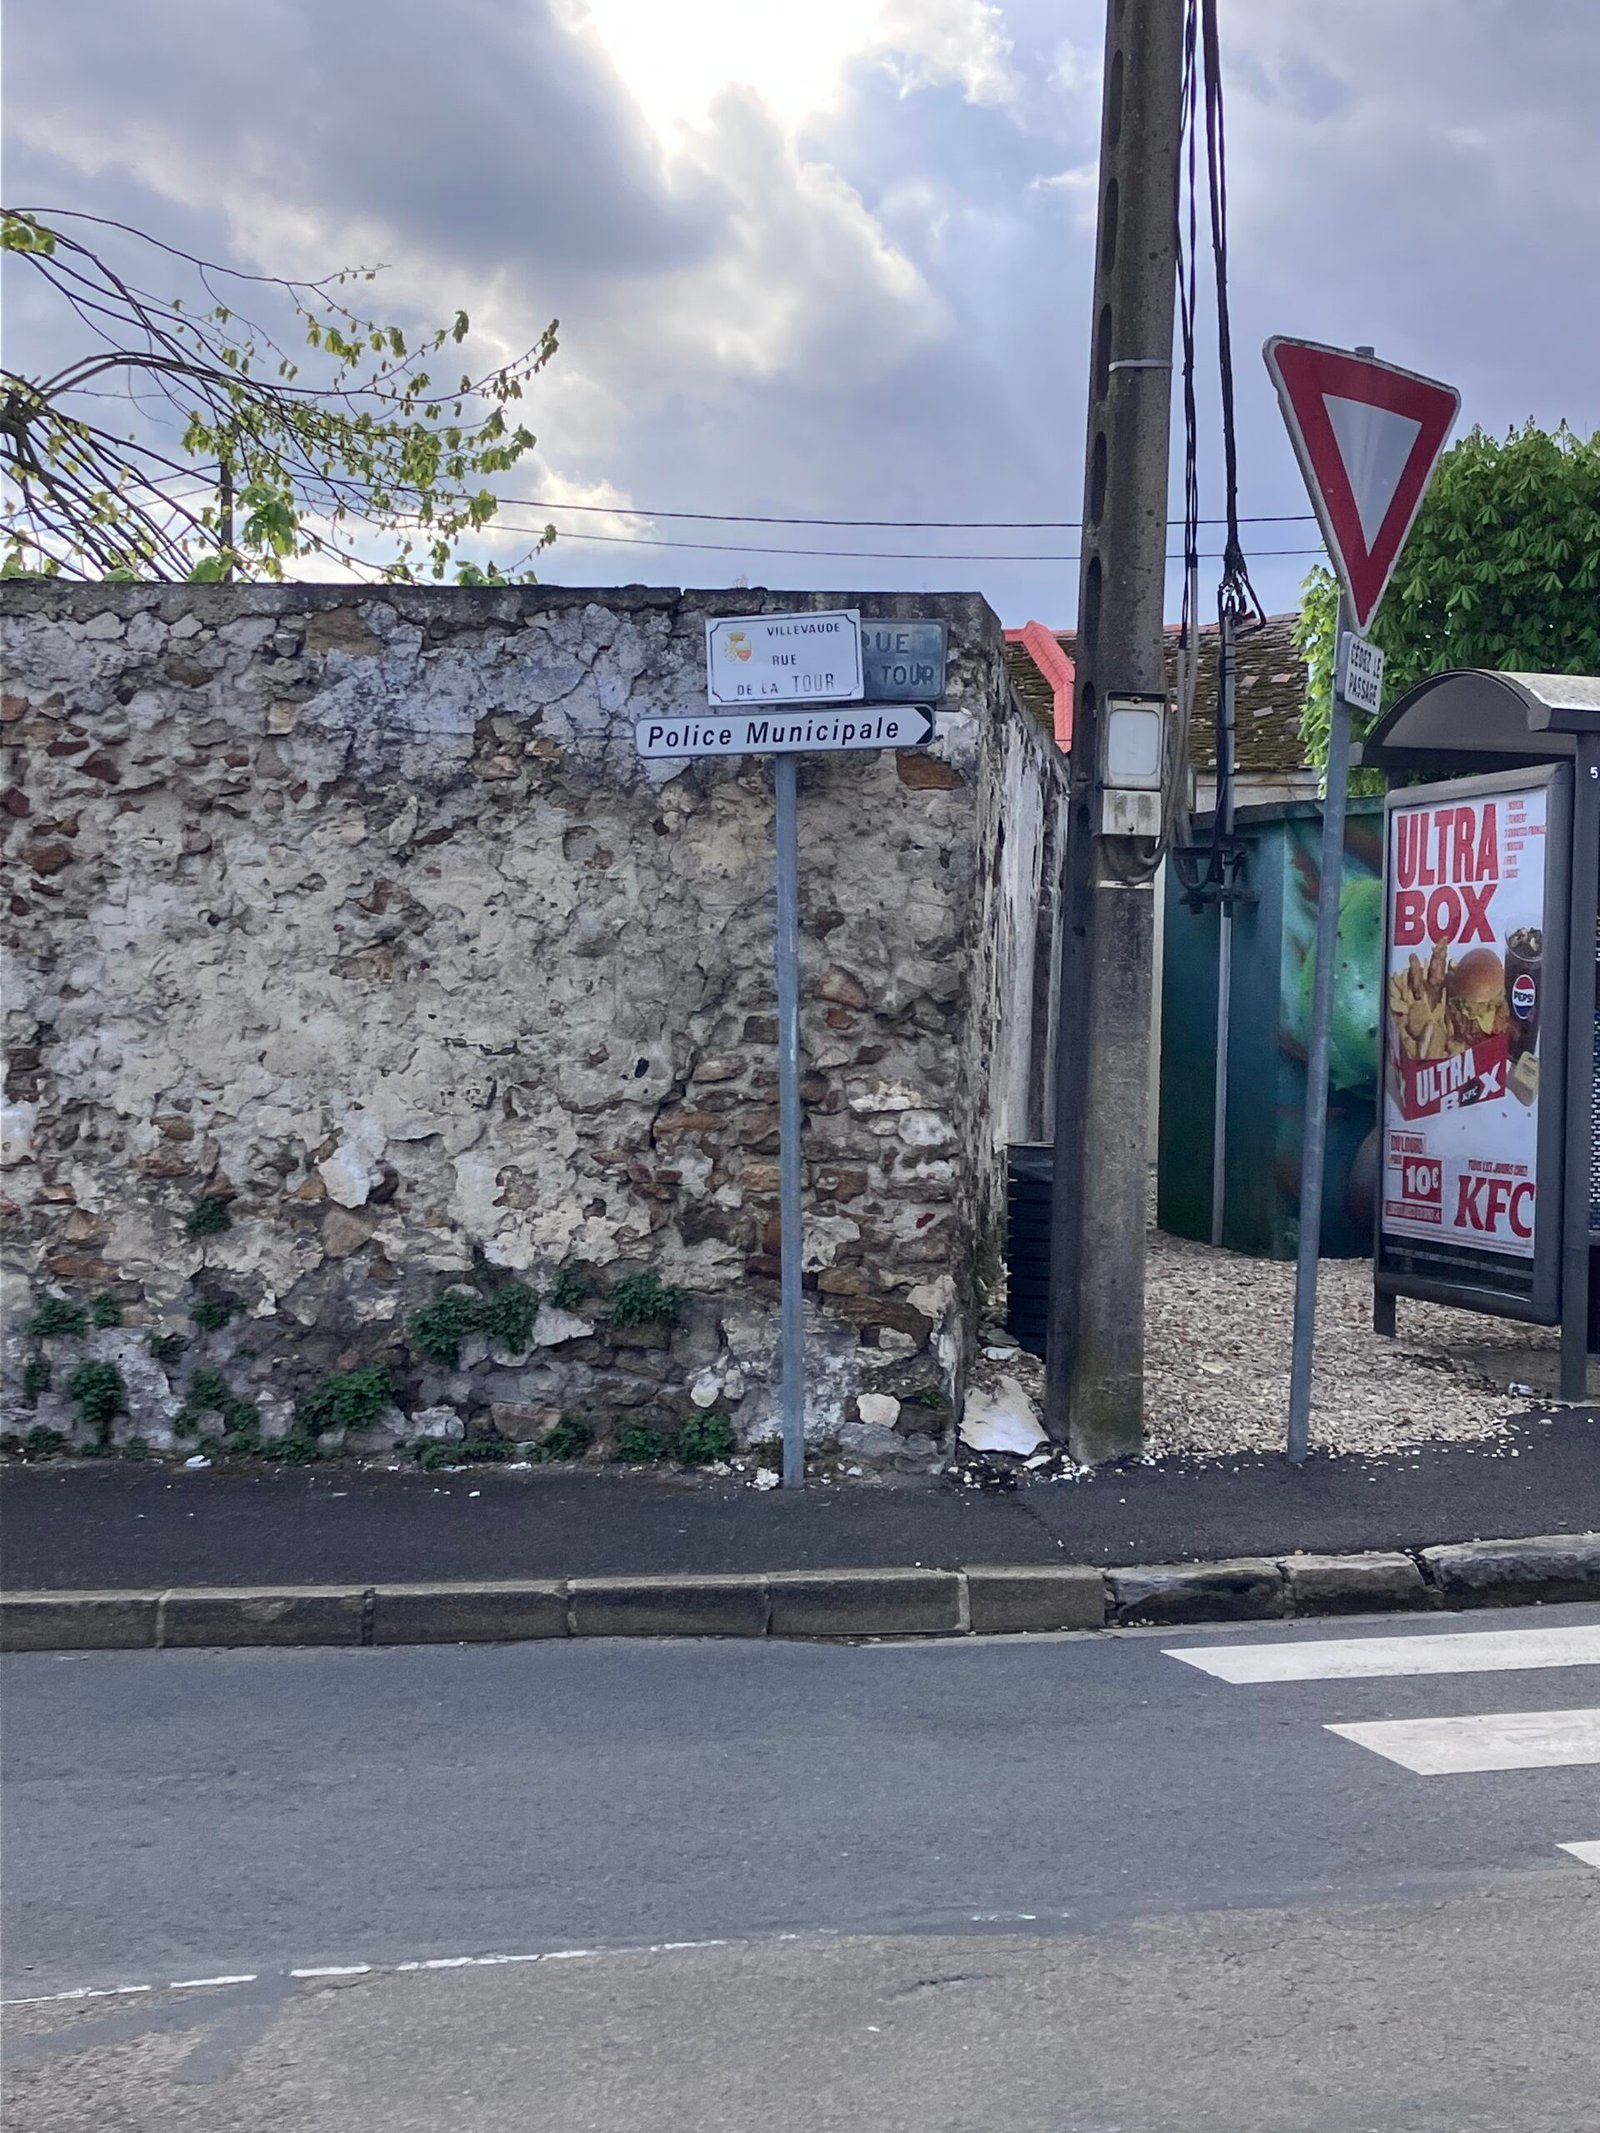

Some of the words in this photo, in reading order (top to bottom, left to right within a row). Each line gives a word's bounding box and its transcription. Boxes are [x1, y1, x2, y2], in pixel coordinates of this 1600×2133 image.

[766, 622, 841, 636] VILLEVAUDE
[772, 654, 797, 666] RUE
[880, 663, 935, 686] TOUR
[737, 684, 753, 696] DE
[761, 683, 778, 694] LA
[792, 673, 835, 693] TOUR
[1348, 672, 1378, 706] PASSAGE
[648, 724, 732, 748] Police
[746, 717, 899, 746] Municipale
[1590, 766, 1599, 779] 5
[1397, 803, 1499, 889] ULTRA
[1393, 884, 1498, 946] BOX
[1513, 990, 1534, 1004] PEPSI
[1415, 1048, 1477, 1107] ULTRA
[1406, 1164, 1440, 1196] 10€
[1454, 1175, 1535, 1238] KFC
